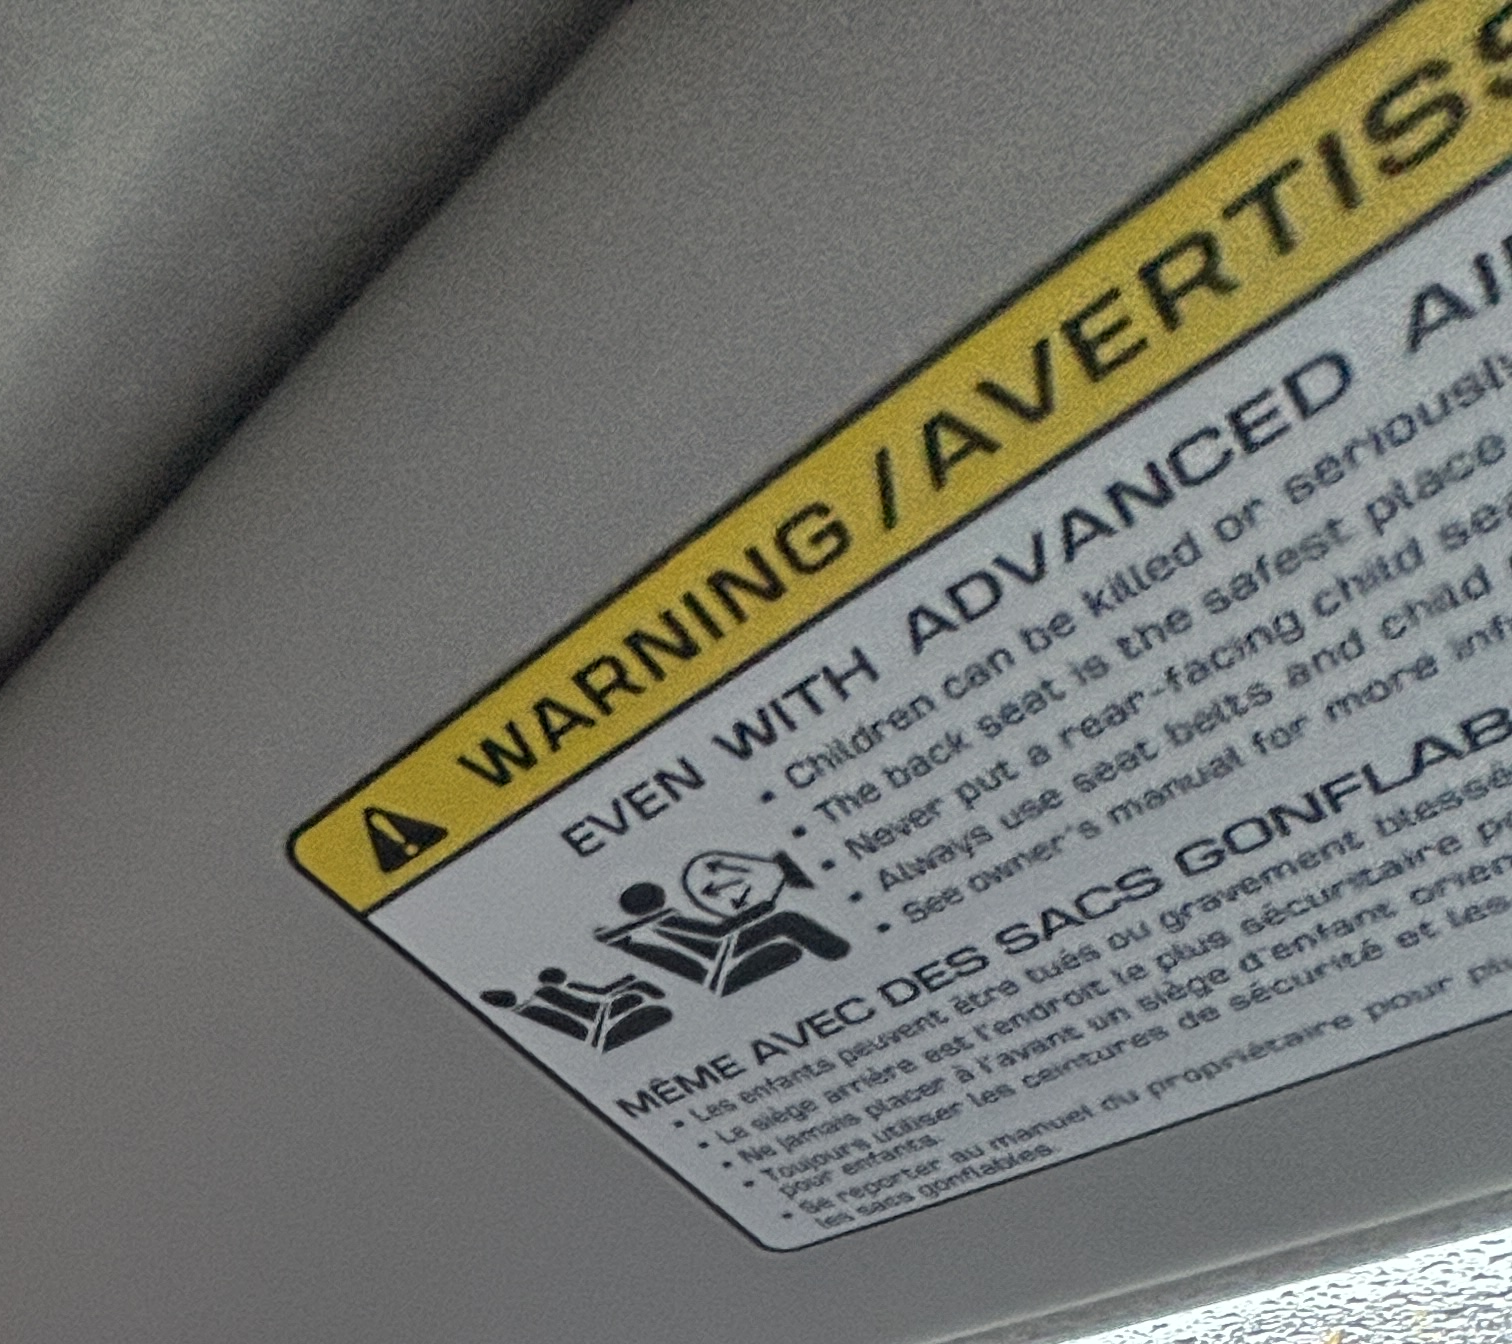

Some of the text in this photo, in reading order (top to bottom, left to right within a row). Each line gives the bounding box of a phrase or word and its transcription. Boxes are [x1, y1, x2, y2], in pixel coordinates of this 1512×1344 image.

[457, 501, 852, 788] WARNING
[561, 235, 1512, 858] EVEN WITH ADVANCED AI
[784, 693, 936, 789] Children
[942, 648, 1015, 699] can
[1020, 611, 1076, 654] be
[1082, 532, 1202, 618] killed
[1214, 498, 1264, 543] or
[813, 433, 1506, 823] The back seat is the safest place
[844, 798, 945, 861] Never
[955, 757, 1020, 810] put
[1027, 743, 1052, 767] a
[1058, 609, 1306, 750] rear-facing
[1312, 535, 1426, 617] child
[879, 561, 1493, 891] Always use seat belts and child
[901, 885, 965, 924] See
[967, 820, 1102, 893] owner's
[1106, 745, 1246, 825] manual
[1251, 713, 1309, 755] for
[1324, 654, 1439, 723] more
[616, 707, 1512, 1120] MÊME AVEC DES SACS GONFLAB
[690, 1097, 738, 1124] Les
[740, 1056, 836, 1104] enfants
[838, 1008, 950, 1067] peuvent
[954, 978, 1020, 1016] être
[1024, 944, 1101, 985] tués
[1107, 919, 1152, 951] ou
[1159, 829, 1365, 934] gravement
[715, 1121, 750, 1145] Le
[751, 1097, 819, 1133] siège
[824, 1055, 919, 1106] arrière
[924, 1032, 976, 1065] est
[974, 977, 1110, 1043] l'endroit
[1112, 963, 1149, 987] le
[1156, 929, 1232, 974] plus
[1240, 833, 1463, 936] sécuritaire
[738, 1143, 778, 1165] Ne
[778, 1109, 862, 1154] jamais
[864, 1074, 948, 1123] placer
[954, 1064, 976, 1086] à
[976, 1025, 1085, 1073] l'avant
[1088, 1005, 1133, 1032] un
[1139, 966, 1232, 1012] siège
[1239, 902, 1397, 973] d'enfant
[760, 895, 1511, 1182] Toujours utiliser les ceintures de sécurité et les
[779, 1168, 833, 1200] pour
[799, 1193, 834, 1215] Se
[836, 1157, 942, 1205] reporter
[949, 1143, 985, 1164] au
[989, 1102, 1096, 1151] manuel
[1100, 1088, 1140, 1112] du
[1146, 1013, 1355, 1101] propriétaire
[1364, 976, 1453, 1023] pour
[814, 1212, 855, 1229] les
[856, 1190, 915, 1217] sacs
